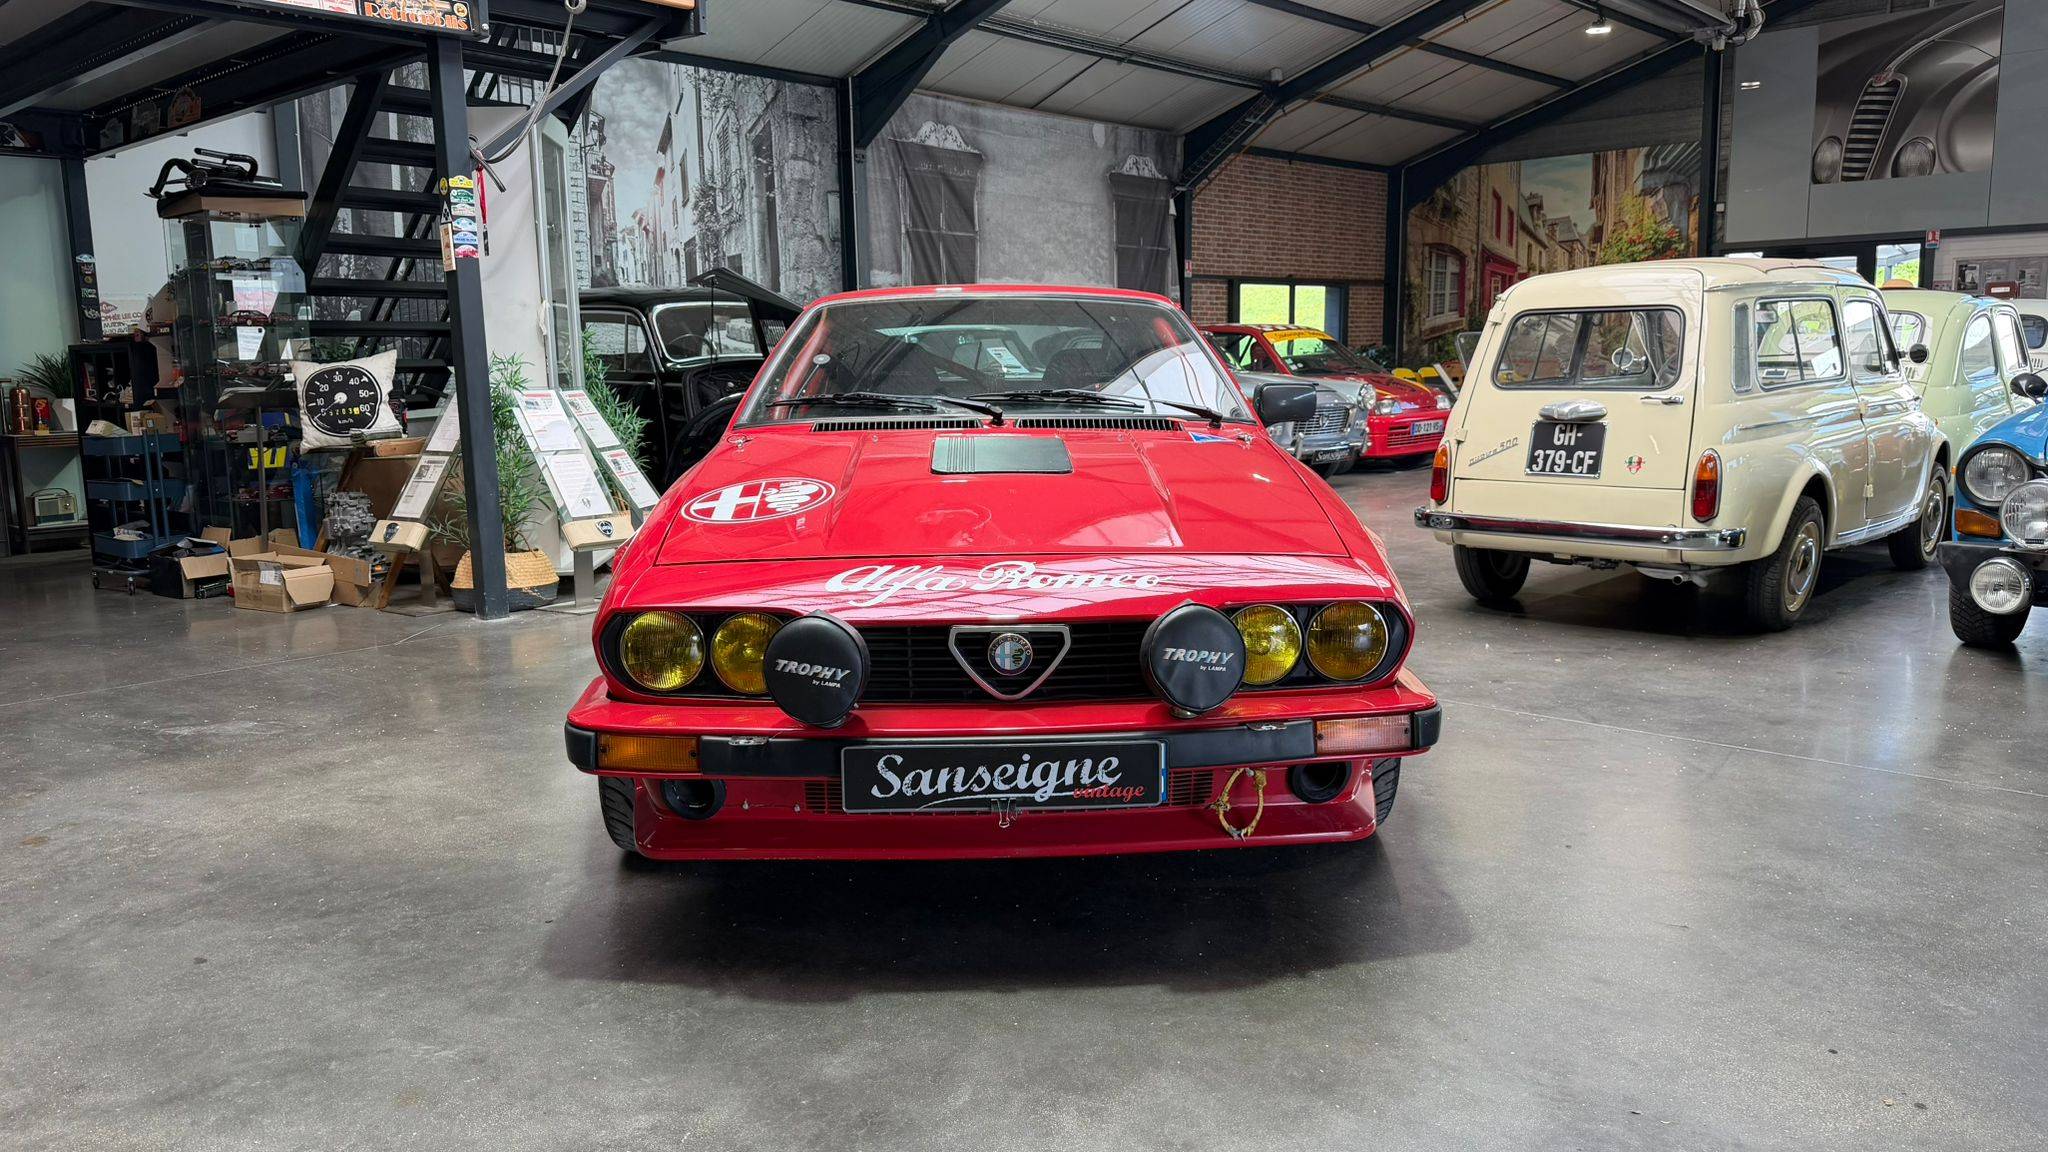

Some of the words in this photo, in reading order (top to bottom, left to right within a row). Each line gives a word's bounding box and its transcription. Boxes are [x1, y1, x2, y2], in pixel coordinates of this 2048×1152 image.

[333, 374, 343, 382] 30
[349, 377, 359, 385] 40
[317, 398, 325, 406] 10
[359, 389, 369, 397] 50
[359, 404, 370, 412] 60
[1553, 424, 1583, 446] GH-
[1531, 449, 1597, 474] 379-CF
[824, 564, 967, 608] Alfa
[970, 560, 1173, 592] Romeo
[1163, 647, 1234, 665] TROPHY
[775, 659, 851, 681] TROPHY
[821, 680, 841, 688] LAMPA
[870, 753, 1123, 802] Sanseigne
[1072, 783, 1146, 802] vintage
